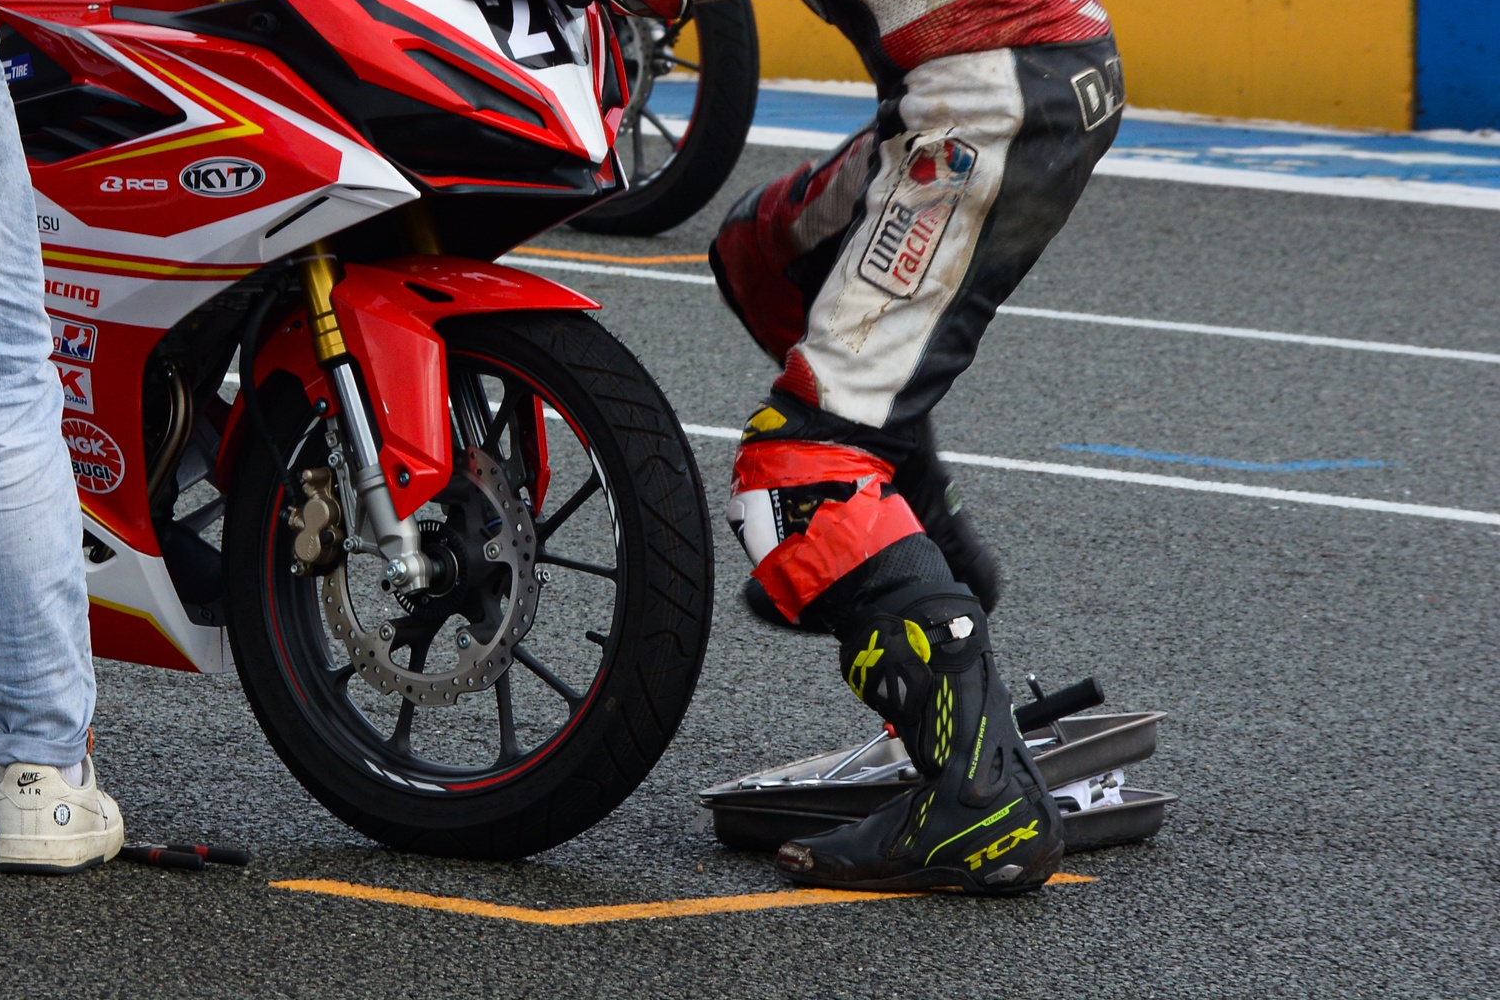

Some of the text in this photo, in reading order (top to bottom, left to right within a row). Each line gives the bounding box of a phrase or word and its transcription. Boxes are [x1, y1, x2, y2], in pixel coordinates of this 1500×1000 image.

[11, 63, 28, 77] TIRE
[126, 178, 168, 191] RCB
[191, 166, 252, 190] KYT
[868, 201, 914, 273] uma
[64, 394, 88, 406] CHAIN
[65, 435, 107, 457] NGK
[21, 772, 40, 781] NIKE
[19, 788, 41, 796] AIR
[964, 819, 1039, 871] TCX
